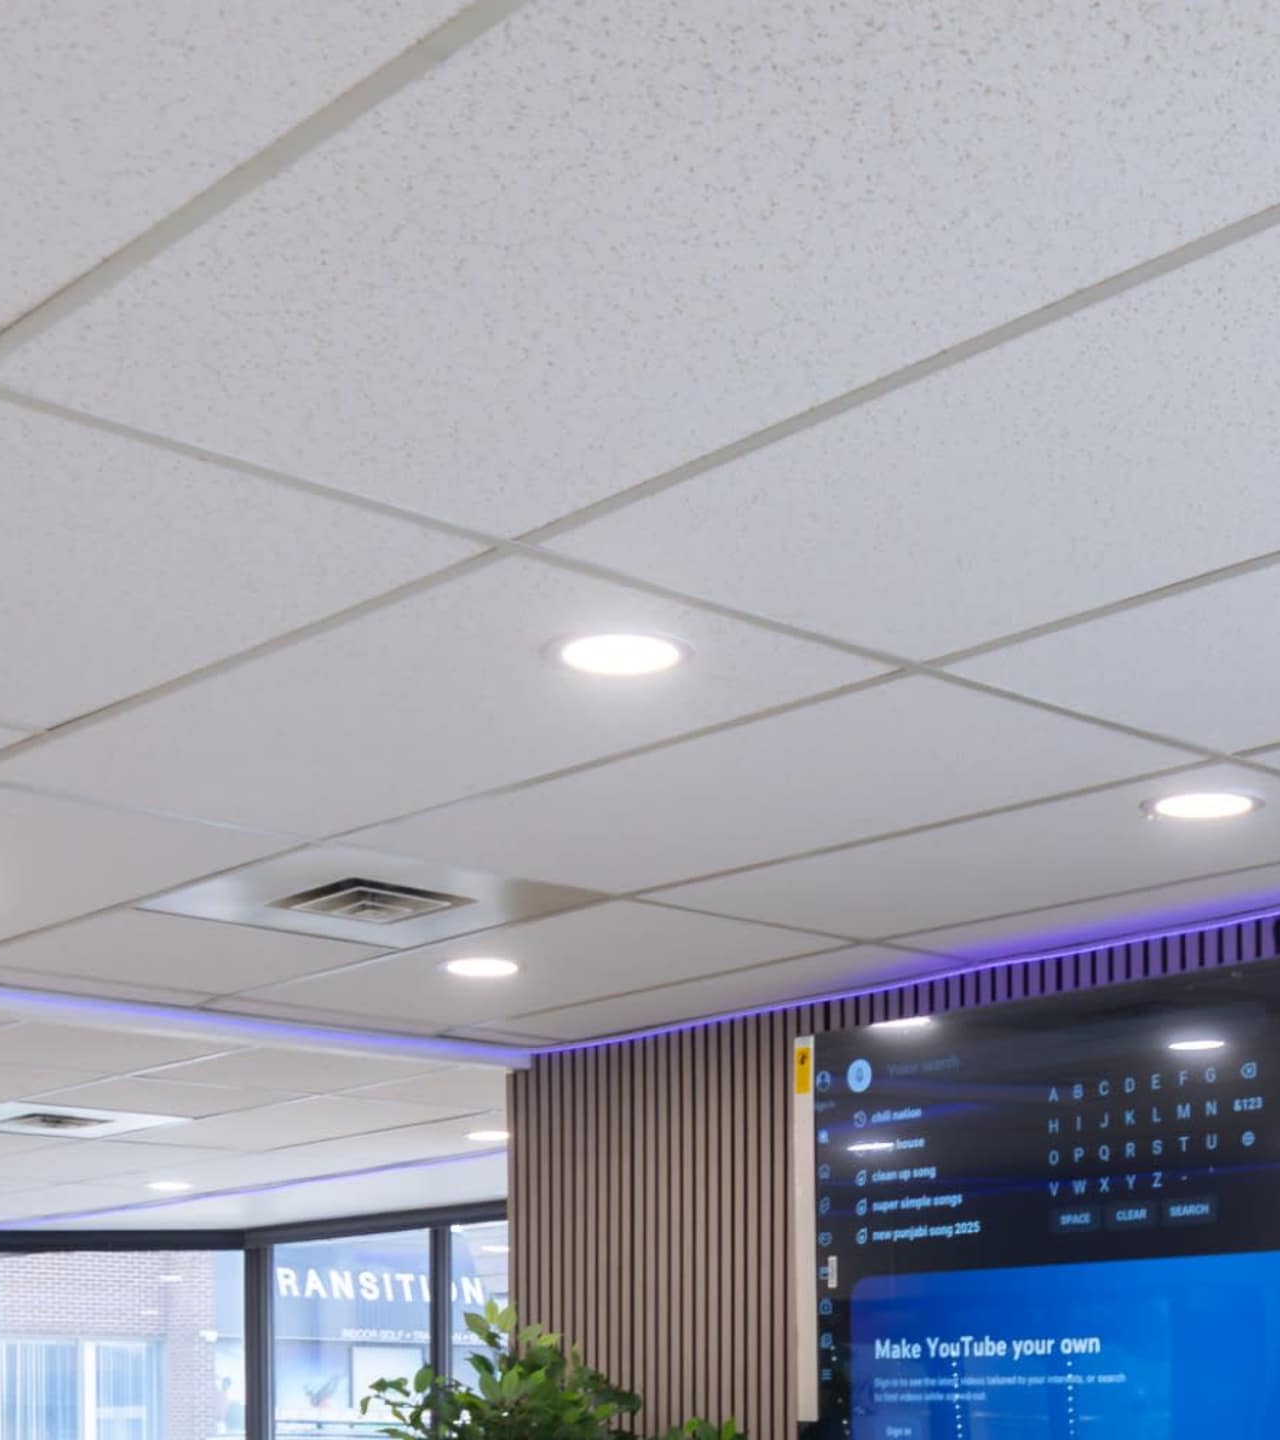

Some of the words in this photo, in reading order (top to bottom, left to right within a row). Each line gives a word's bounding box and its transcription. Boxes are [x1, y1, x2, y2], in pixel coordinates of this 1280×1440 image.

[1048, 1087, 1059, 1102] A
[1072, 1084, 1084, 1099] B
[1098, 1080, 1110, 1096] C
[1124, 1077, 1136, 1093] D
[1151, 1073, 1161, 1089] E
[1179, 1071, 1188, 1086] F
[1205, 1067, 1216, 1083] G
[1048, 1118, 1059, 1133] H
[1099, 1113, 1109, 1128] J
[1125, 1110, 1135, 1125] K
[1152, 1107, 1161, 1122] L
[1176, 1104, 1191, 1120] M
[1205, 1101, 1217, 1116] N
[1048, 1150, 1059, 1165] O
[1073, 1147, 1084, 1162] P
[1098, 1144, 1110, 1161] Q
[1125, 1142, 1136, 1158] R
[1152, 1139, 1163, 1155] S
[1179, 1136, 1189, 1152] T
[1205, 1133, 1217, 1149] U
[871, 1170, 897, 1183] clean
[898, 1170, 911, 1182] up
[912, 1166, 937, 1179] song
[1049, 1181, 1059, 1197] V
[1072, 1179, 1087, 1195] W
[1099, 1177, 1110, 1192] X
[1125, 1174, 1136, 1190] Y
[1152, 1171, 1163, 1188] Z
[1169, 1202, 1210, 1217] SEARCH
[954, 1220, 981, 1234] 2025
[275, 1267, 485, 1306] RANSITIN
[874, 1338, 921, 1360] Make
[926, 1335, 1007, 1358] YouTube
[1012, 1337, 1055, 1360] your
[1060, 1336, 1101, 1355] own
